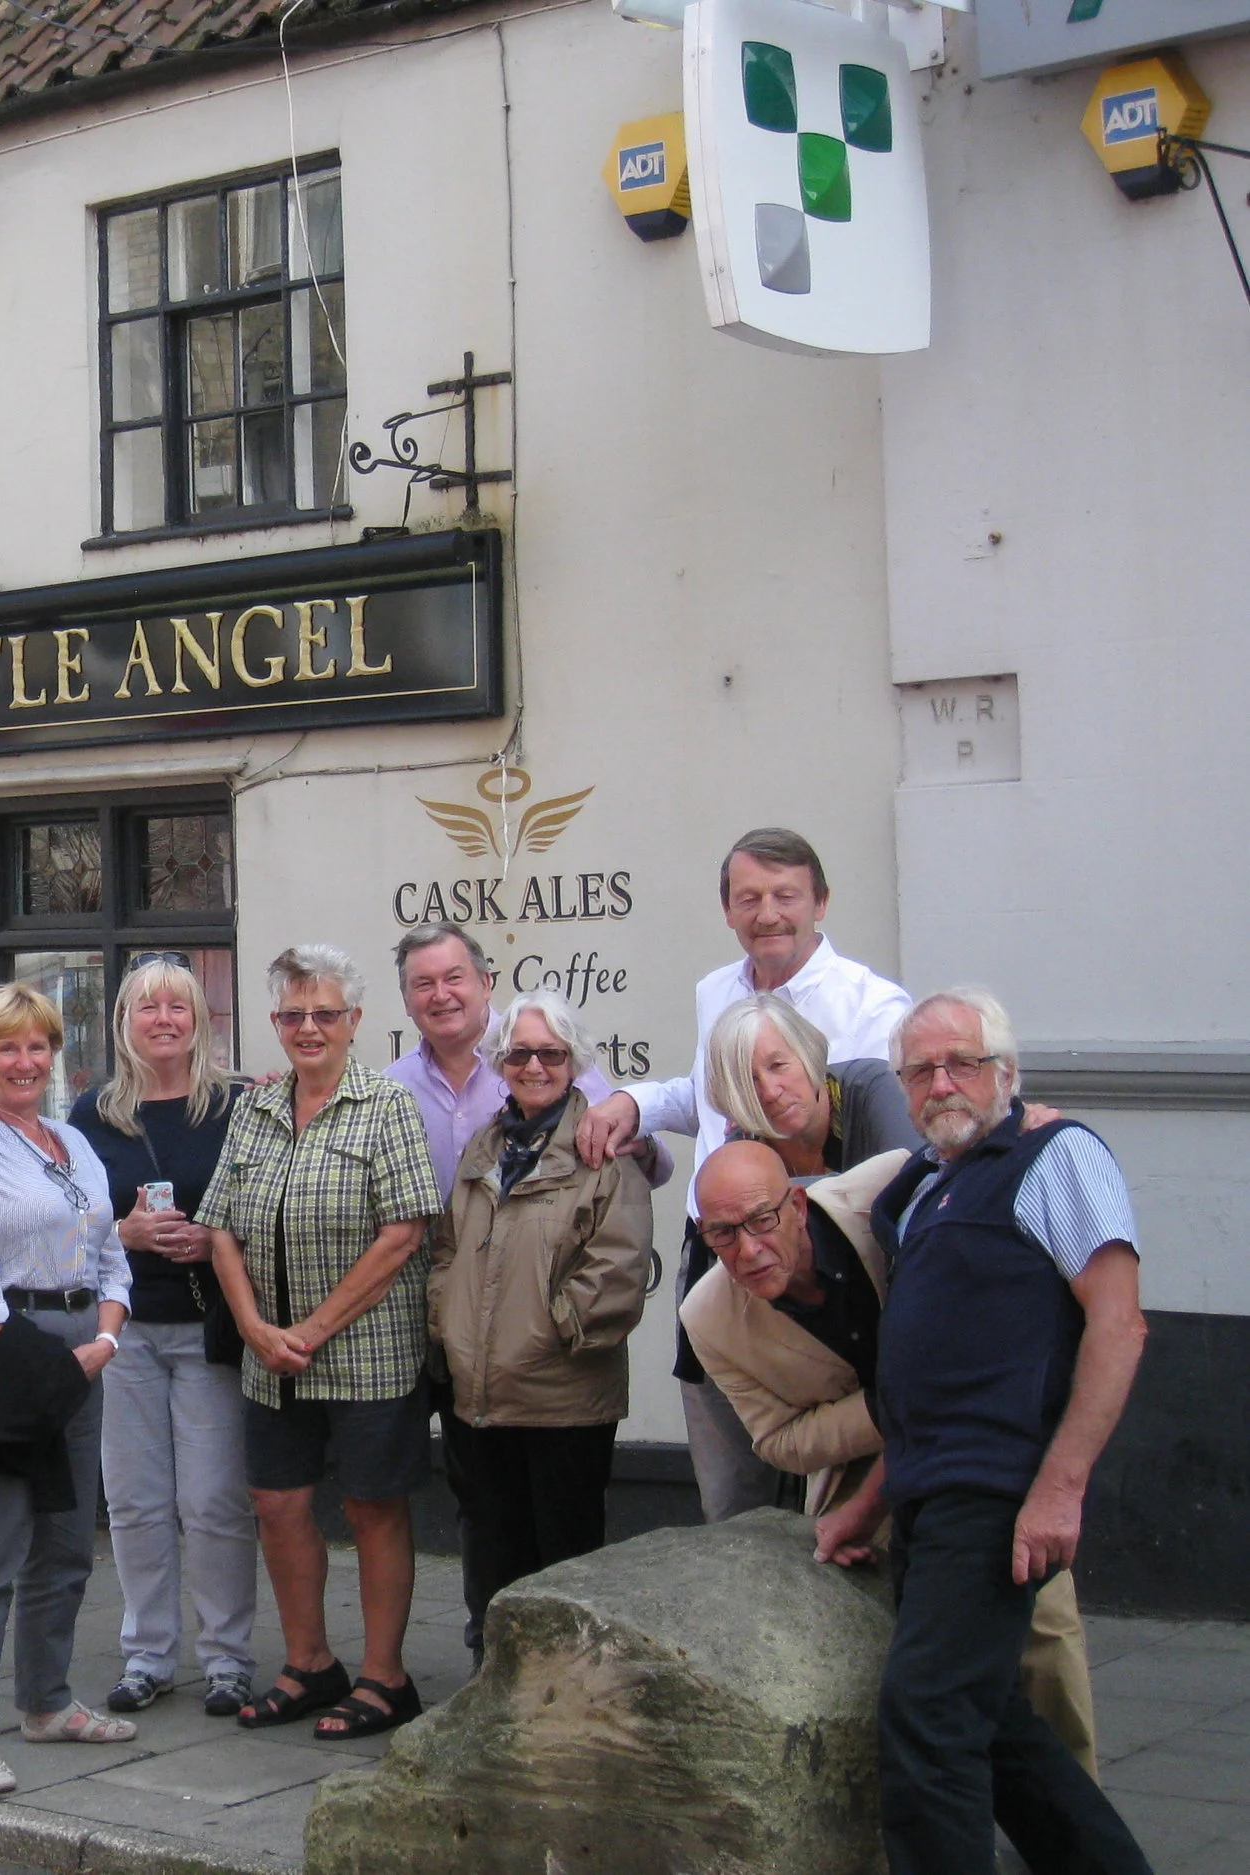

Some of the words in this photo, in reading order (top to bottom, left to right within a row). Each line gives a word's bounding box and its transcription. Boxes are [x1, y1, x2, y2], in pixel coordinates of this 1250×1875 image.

[1104, 98, 1157, 134] ADT
[619, 150, 664, 181] ADT
[113, 594, 394, 699] ANGEL
[393, 877, 508, 926] CASK
[516, 870, 634, 923] ALES
[512, 951, 628, 1009] Coffee
